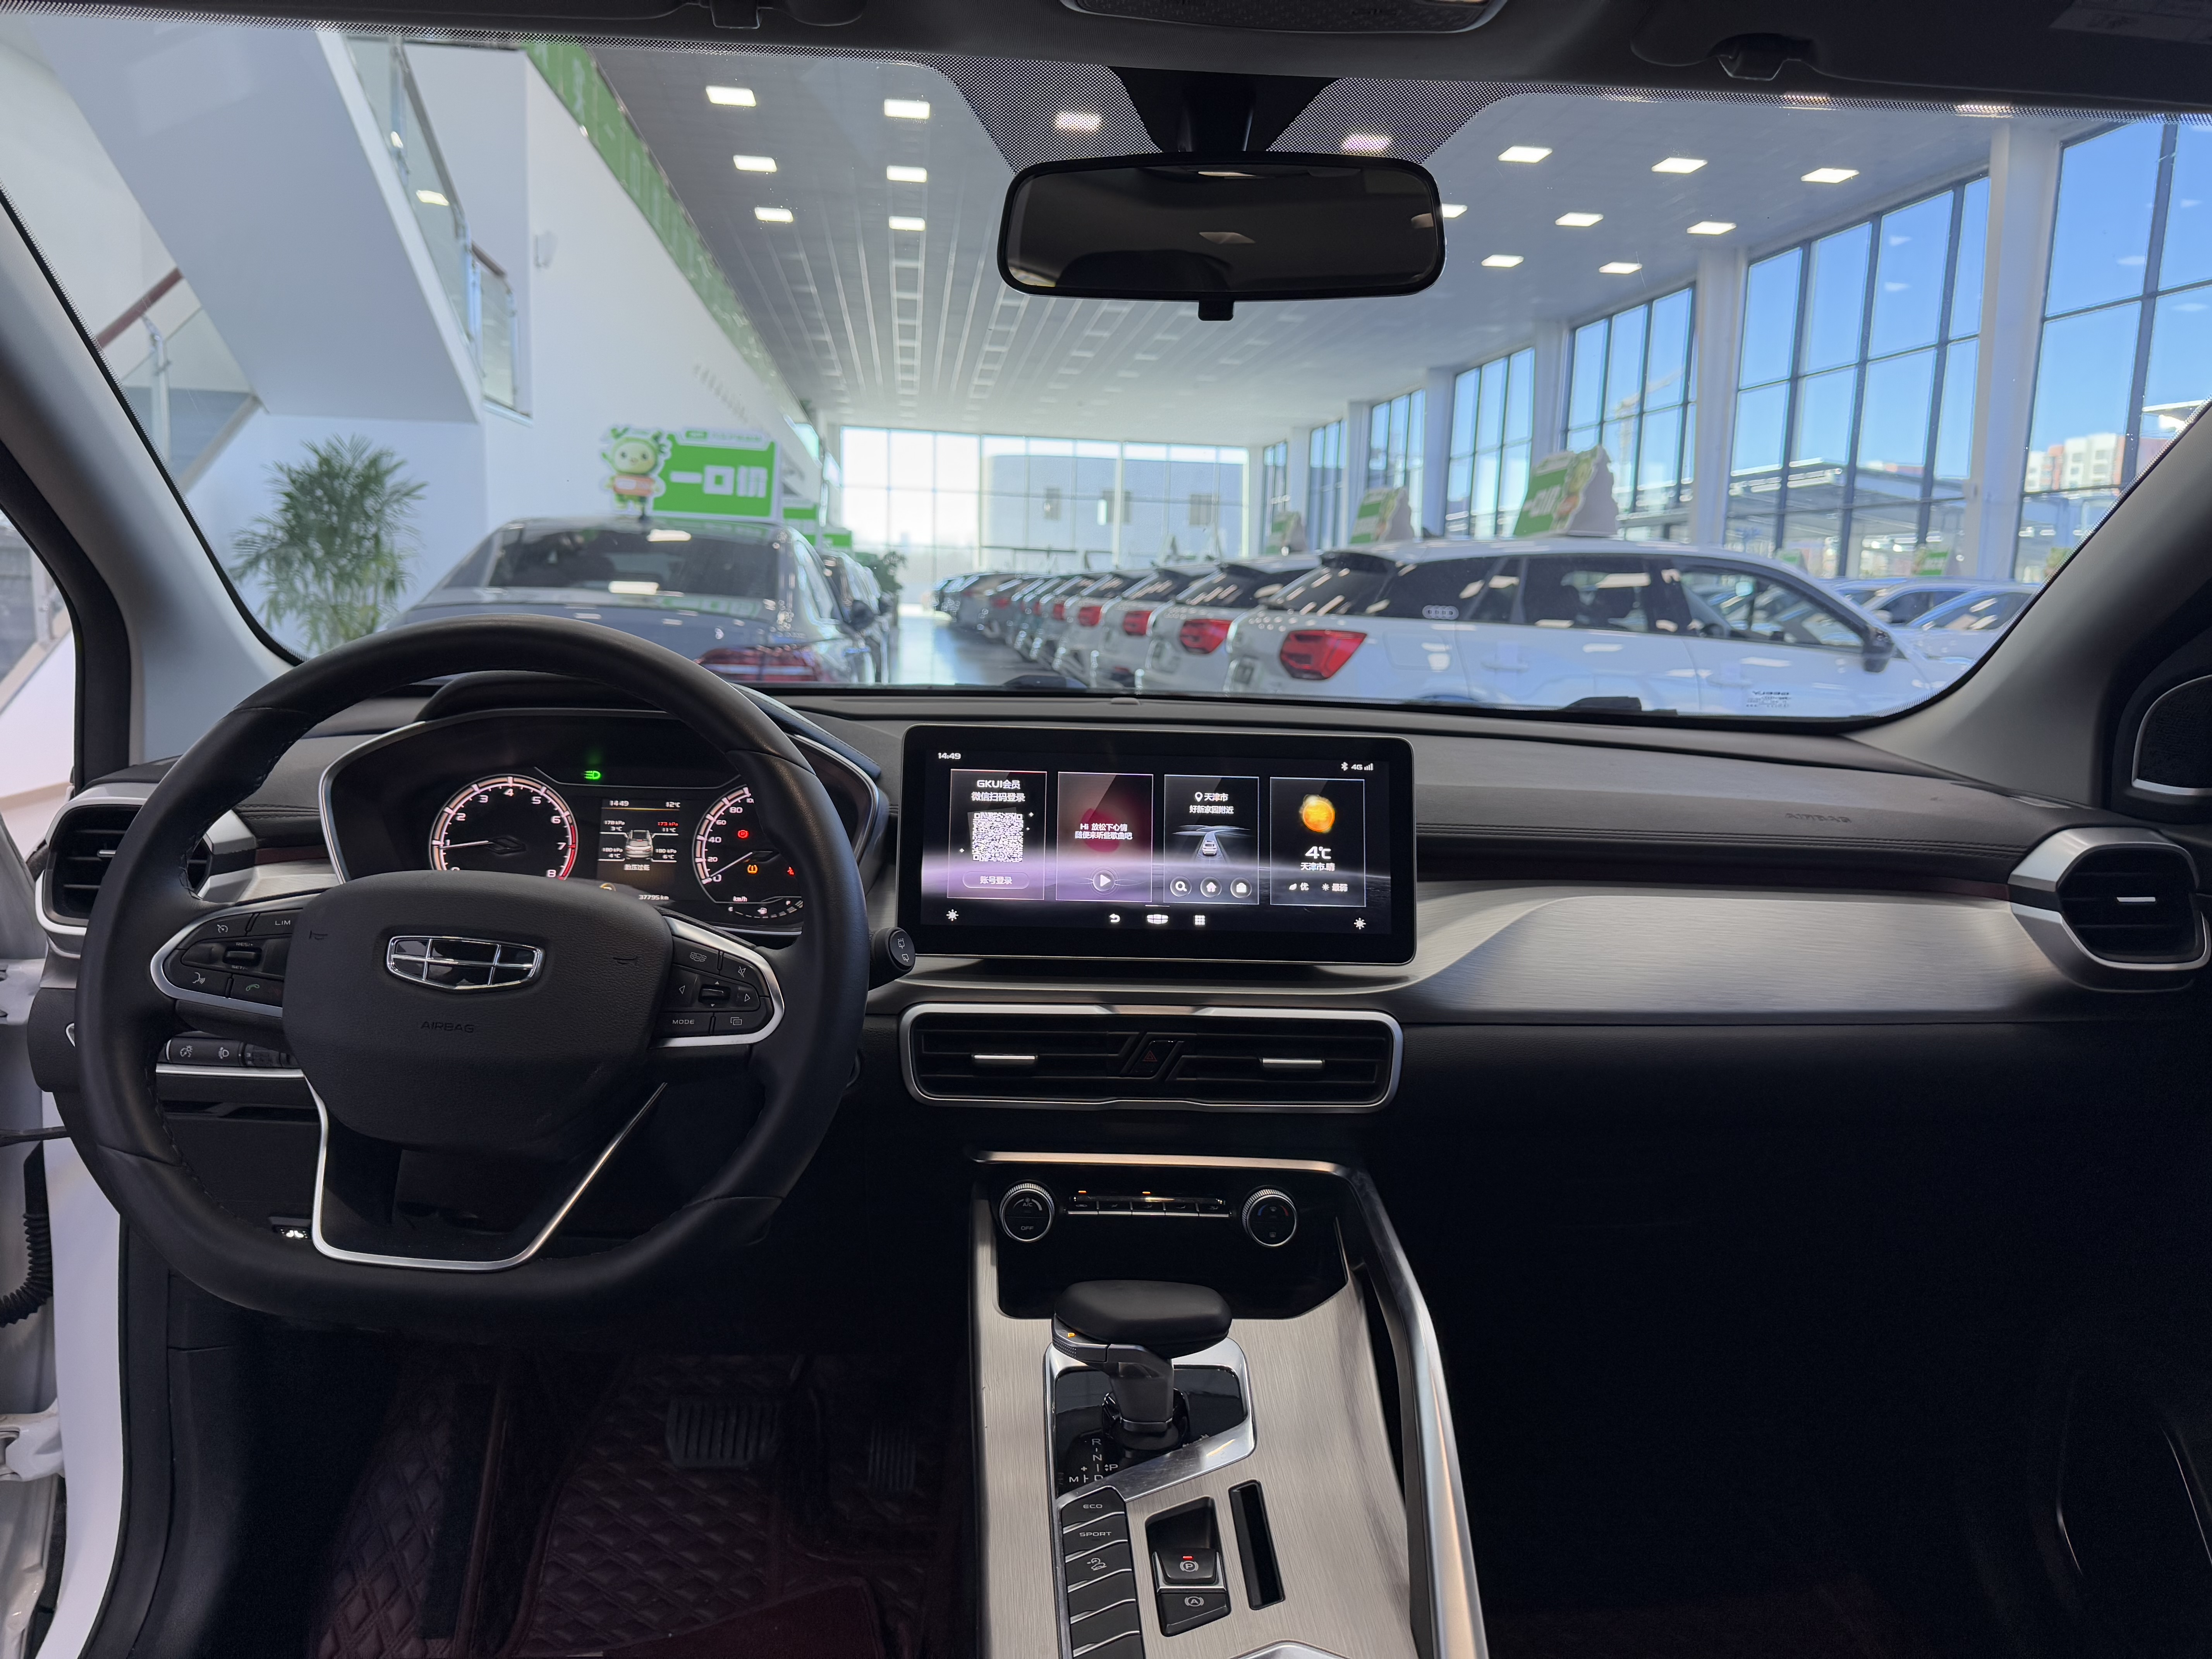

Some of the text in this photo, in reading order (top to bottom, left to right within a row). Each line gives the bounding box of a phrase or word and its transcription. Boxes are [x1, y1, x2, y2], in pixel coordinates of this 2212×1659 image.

[977, 780, 1021, 790] GKUI会员
[971, 792, 1025, 802] 微信扫码登录
[1204, 793, 1228, 802] 天津市
[1091, 823, 1128, 831] 放松下心情
[1075, 831, 1133, 840] 随便来听些歌曲吧
[980, 876, 1013, 884] 账号登录
[1300, 882, 1309, 891] 优
[421, 1021, 475, 1033] AIRBAG
